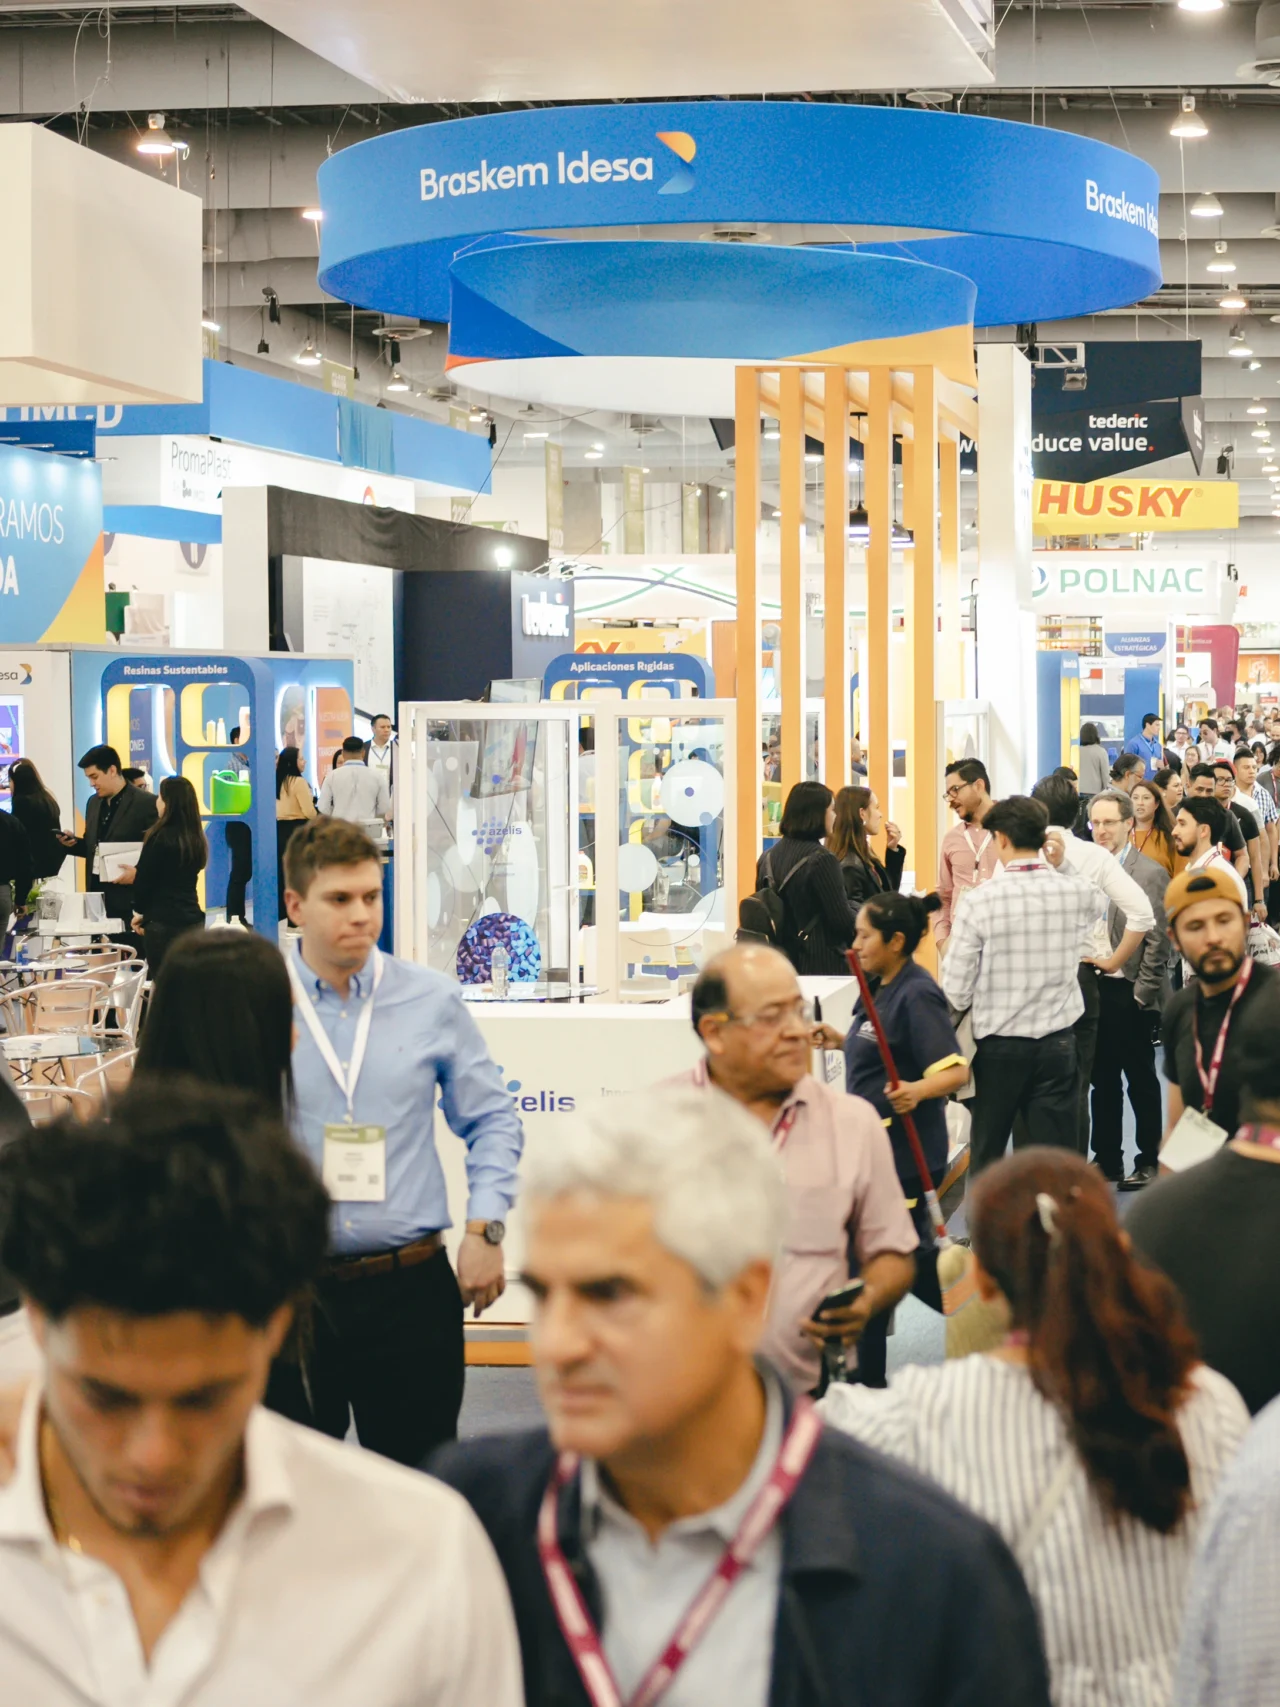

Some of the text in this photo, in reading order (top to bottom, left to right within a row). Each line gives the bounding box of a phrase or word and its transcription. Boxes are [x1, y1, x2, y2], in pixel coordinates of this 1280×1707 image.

[420, 150, 654, 201] Braskem Idesa
[1085, 178, 1147, 229] Braskem
[1089, 413, 1148, 429] tederic
[1087, 432, 1155, 452] value.
[171, 440, 232, 479] PromaPlast
[1038, 483, 1194, 518] HUSKY
[1059, 567, 1204, 594] POLNAC
[123, 663, 229, 676] Resinas Sustentables
[570, 661, 635, 673] Aplicaciones
[488, 825, 523, 836] azelis
